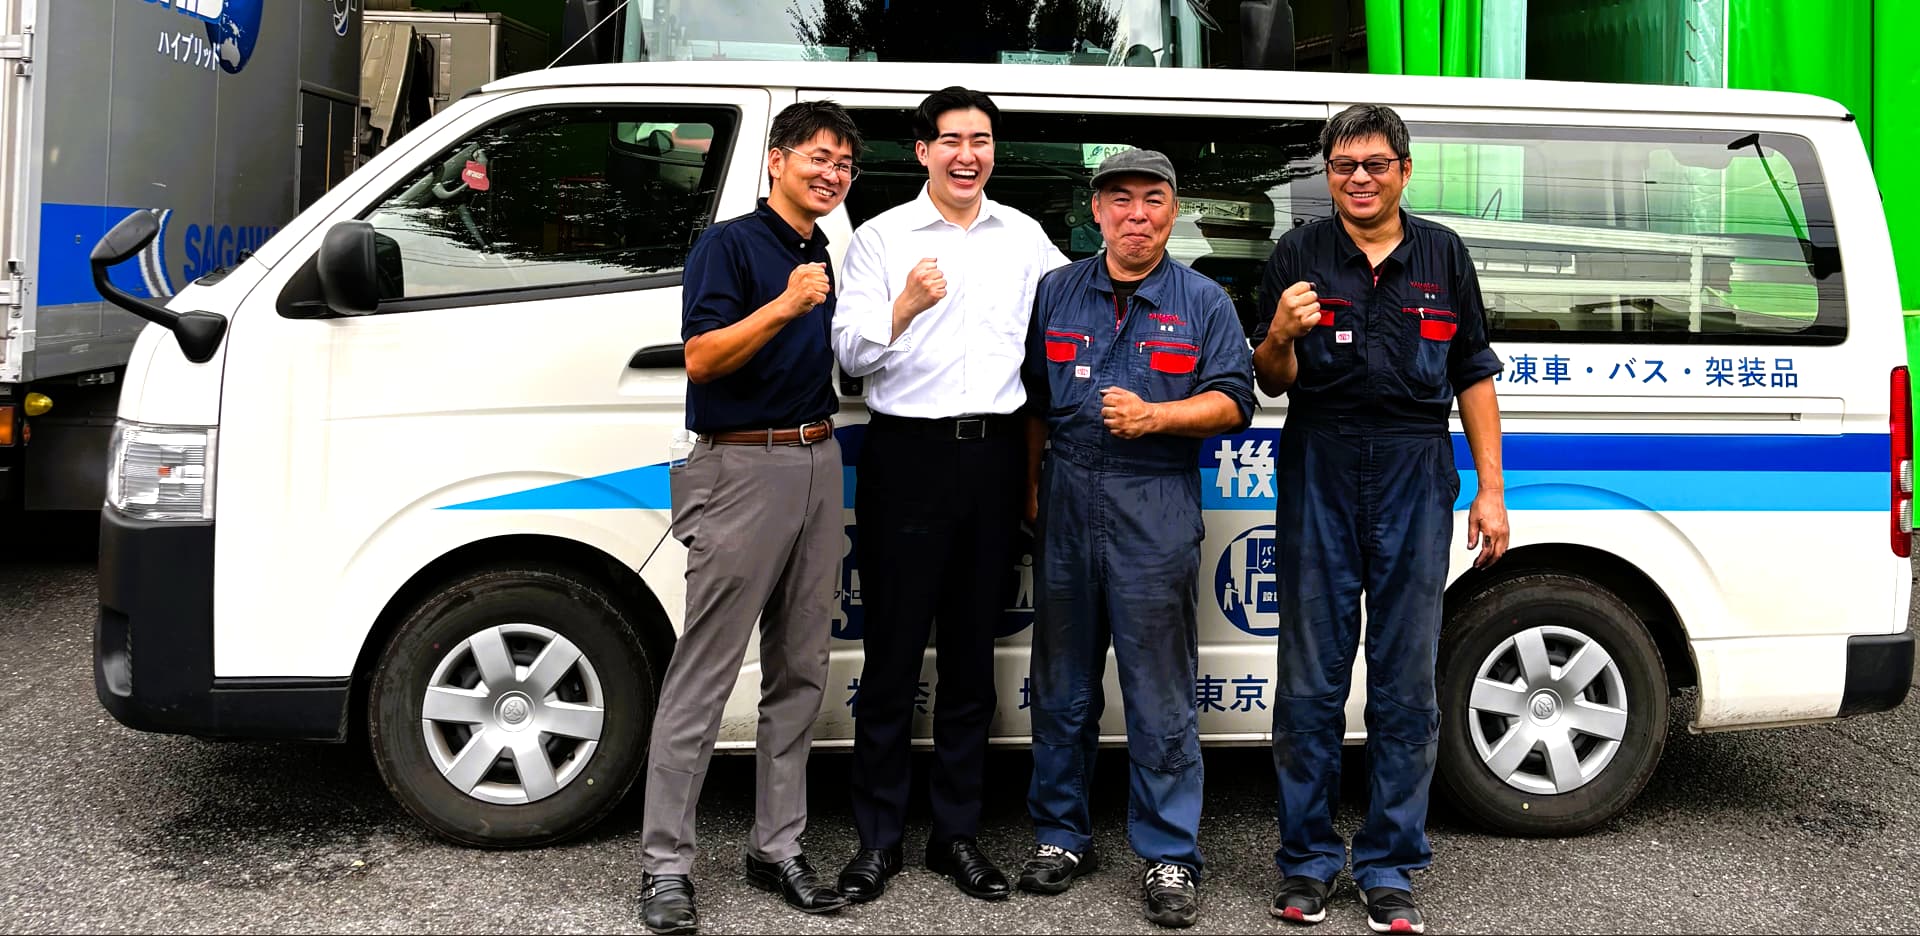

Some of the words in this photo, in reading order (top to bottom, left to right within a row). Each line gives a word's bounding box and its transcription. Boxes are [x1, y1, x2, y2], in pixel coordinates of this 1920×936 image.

[158, 31, 220, 71] ハイブリッド
[1214, 439, 1275, 498] 機
[1196, 674, 1268, 713] 東京
